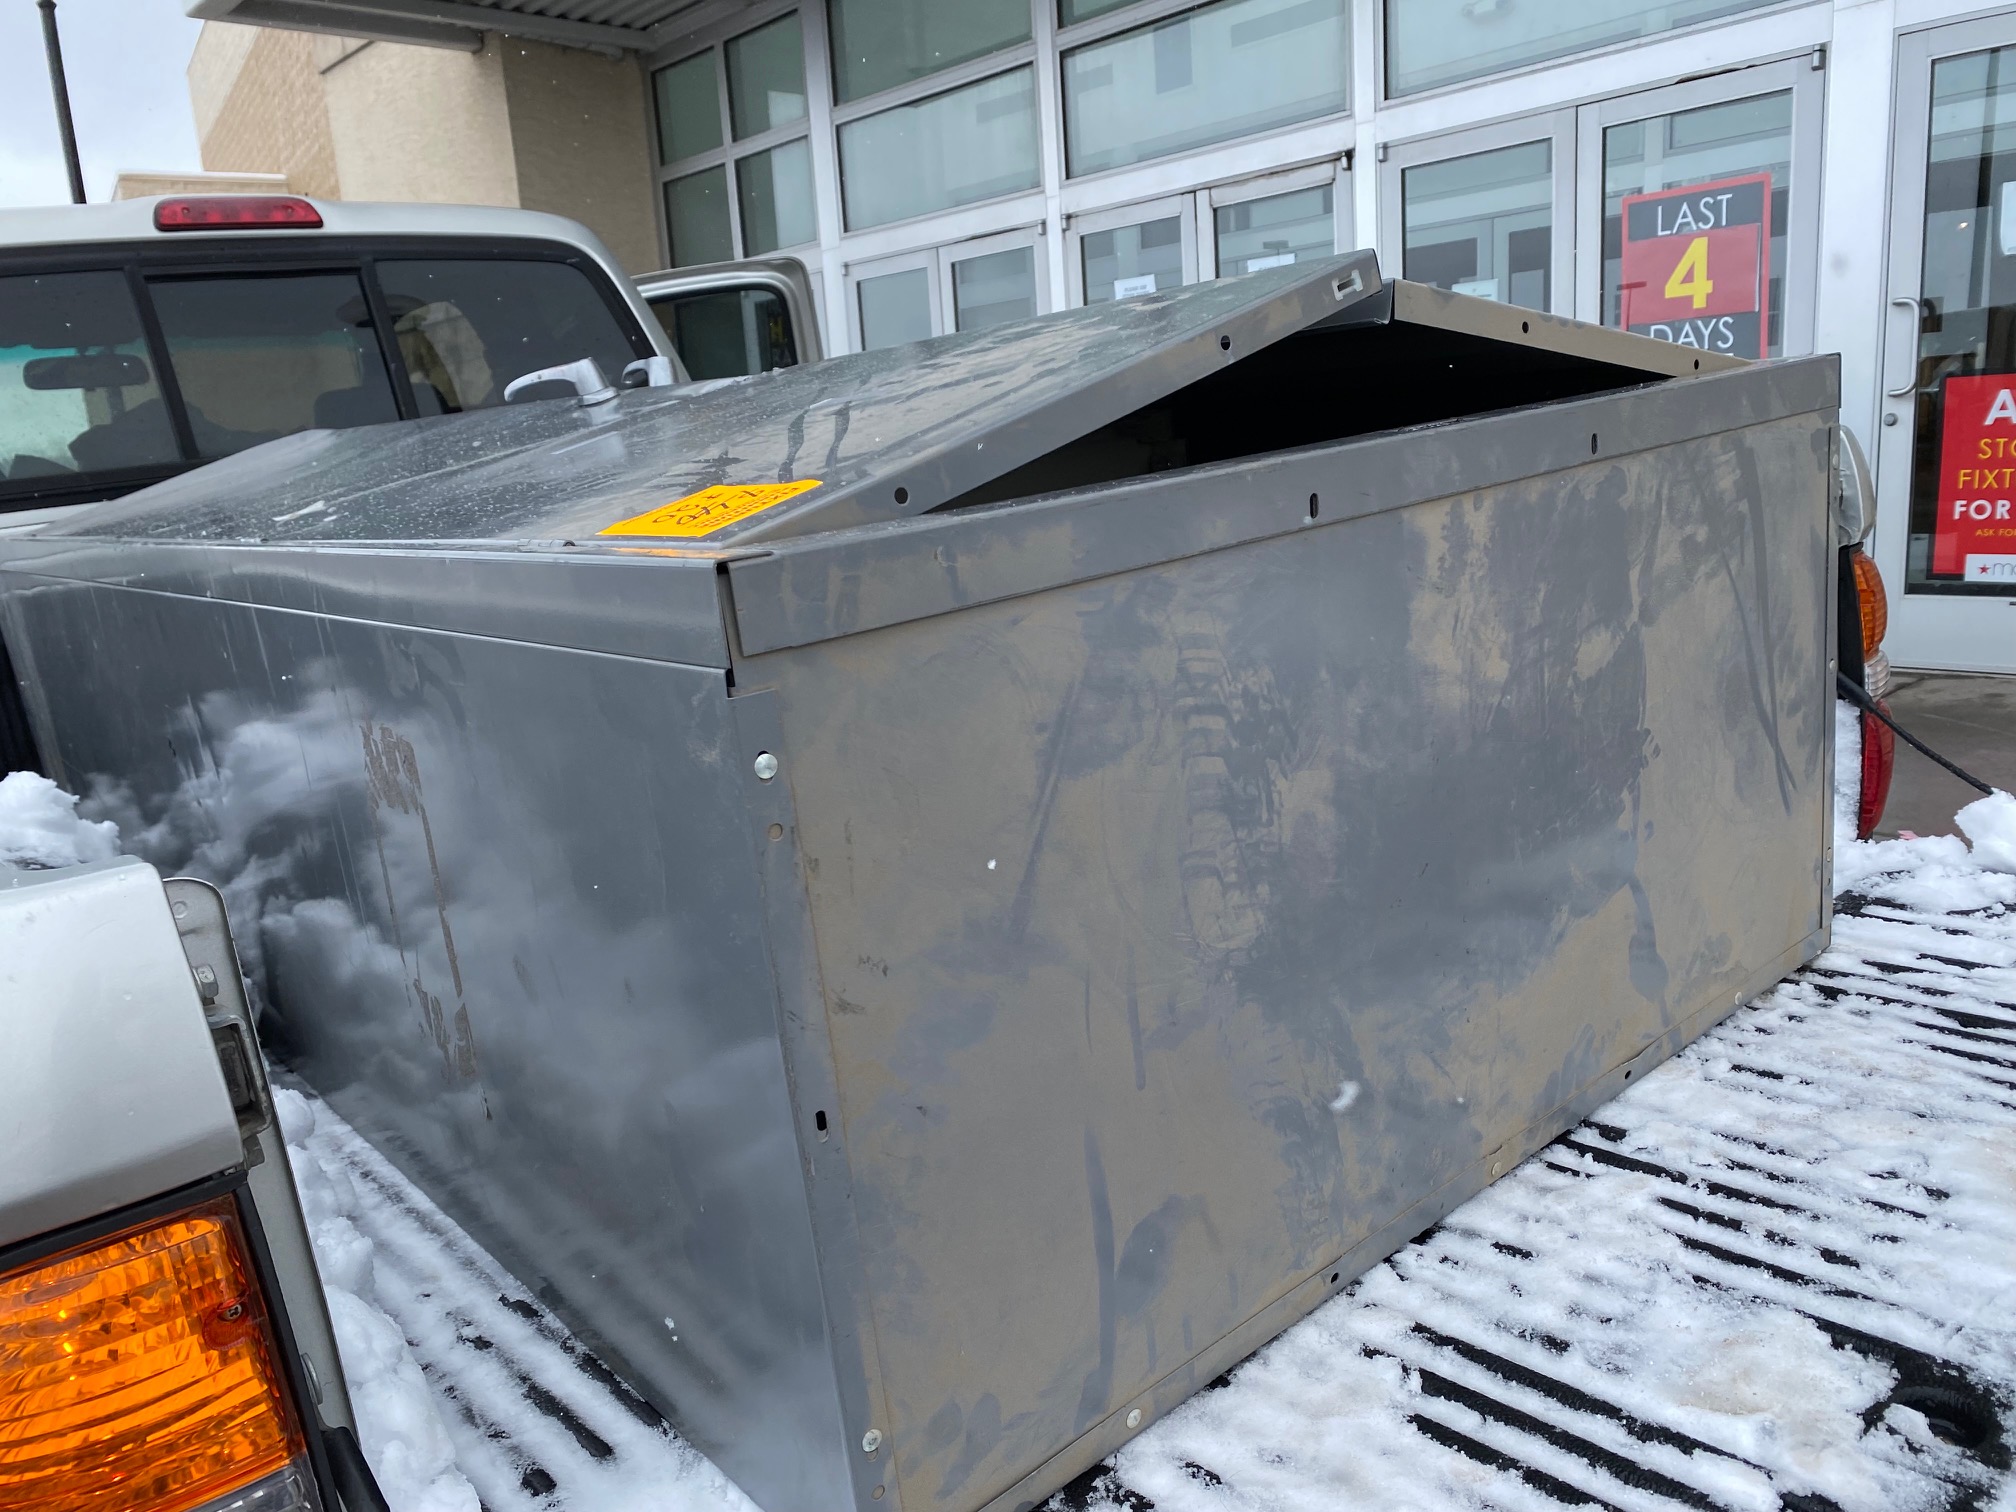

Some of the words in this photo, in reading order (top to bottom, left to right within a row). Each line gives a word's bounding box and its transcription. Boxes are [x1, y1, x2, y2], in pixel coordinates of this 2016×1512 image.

[1657, 193, 1733, 236] LAST
[1665, 236, 1713, 310] 4
[1954, 499, 2011, 520] FOR
[1975, 528, 1996, 537] ASK
[1998, 528, 2016, 537] FO
